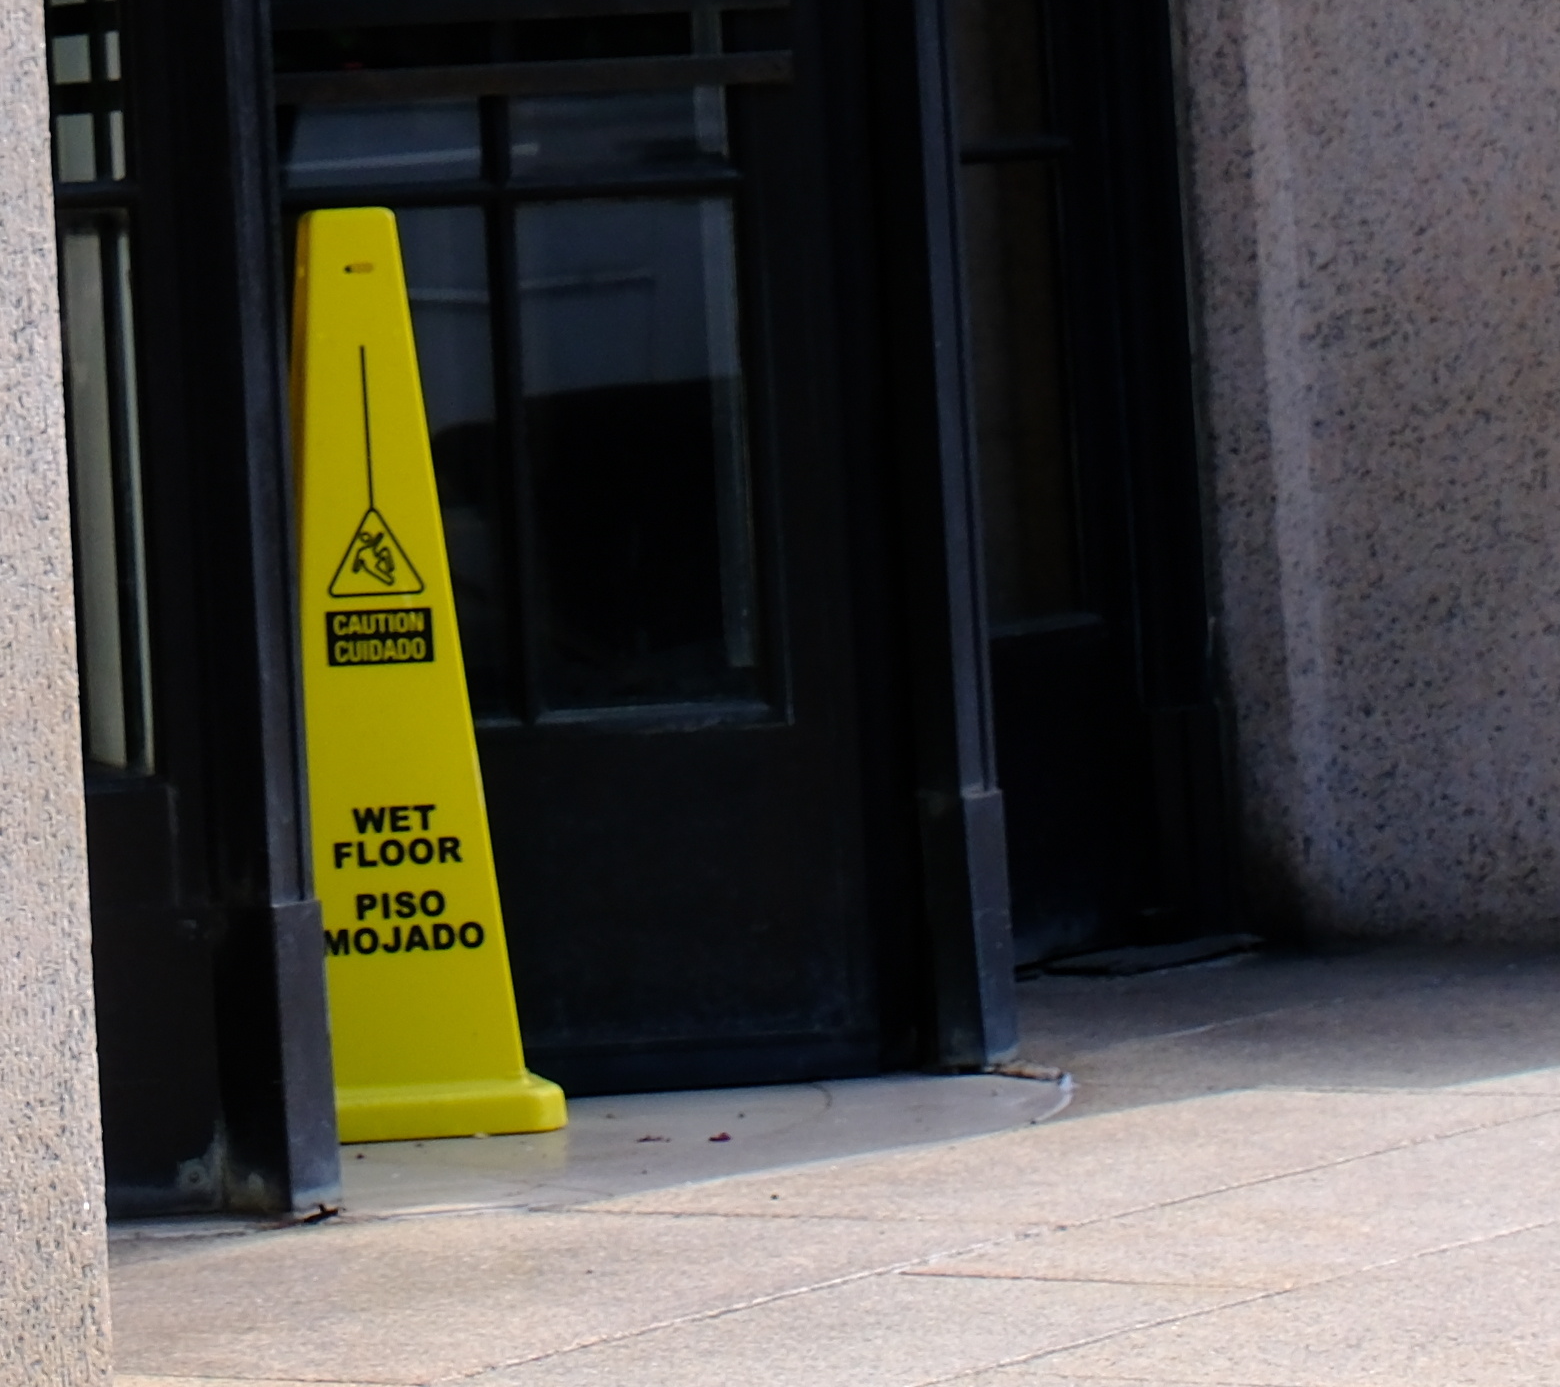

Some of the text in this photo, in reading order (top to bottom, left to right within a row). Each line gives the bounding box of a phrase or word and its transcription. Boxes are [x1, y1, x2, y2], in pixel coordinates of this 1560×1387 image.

[333, 611, 424, 636] CAUTION
[335, 637, 427, 663] CUIDADO
[352, 804, 435, 834] WET
[333, 836, 462, 869] FLOOR
[355, 890, 445, 921] PISO
[324, 922, 484, 957] MOJADO
